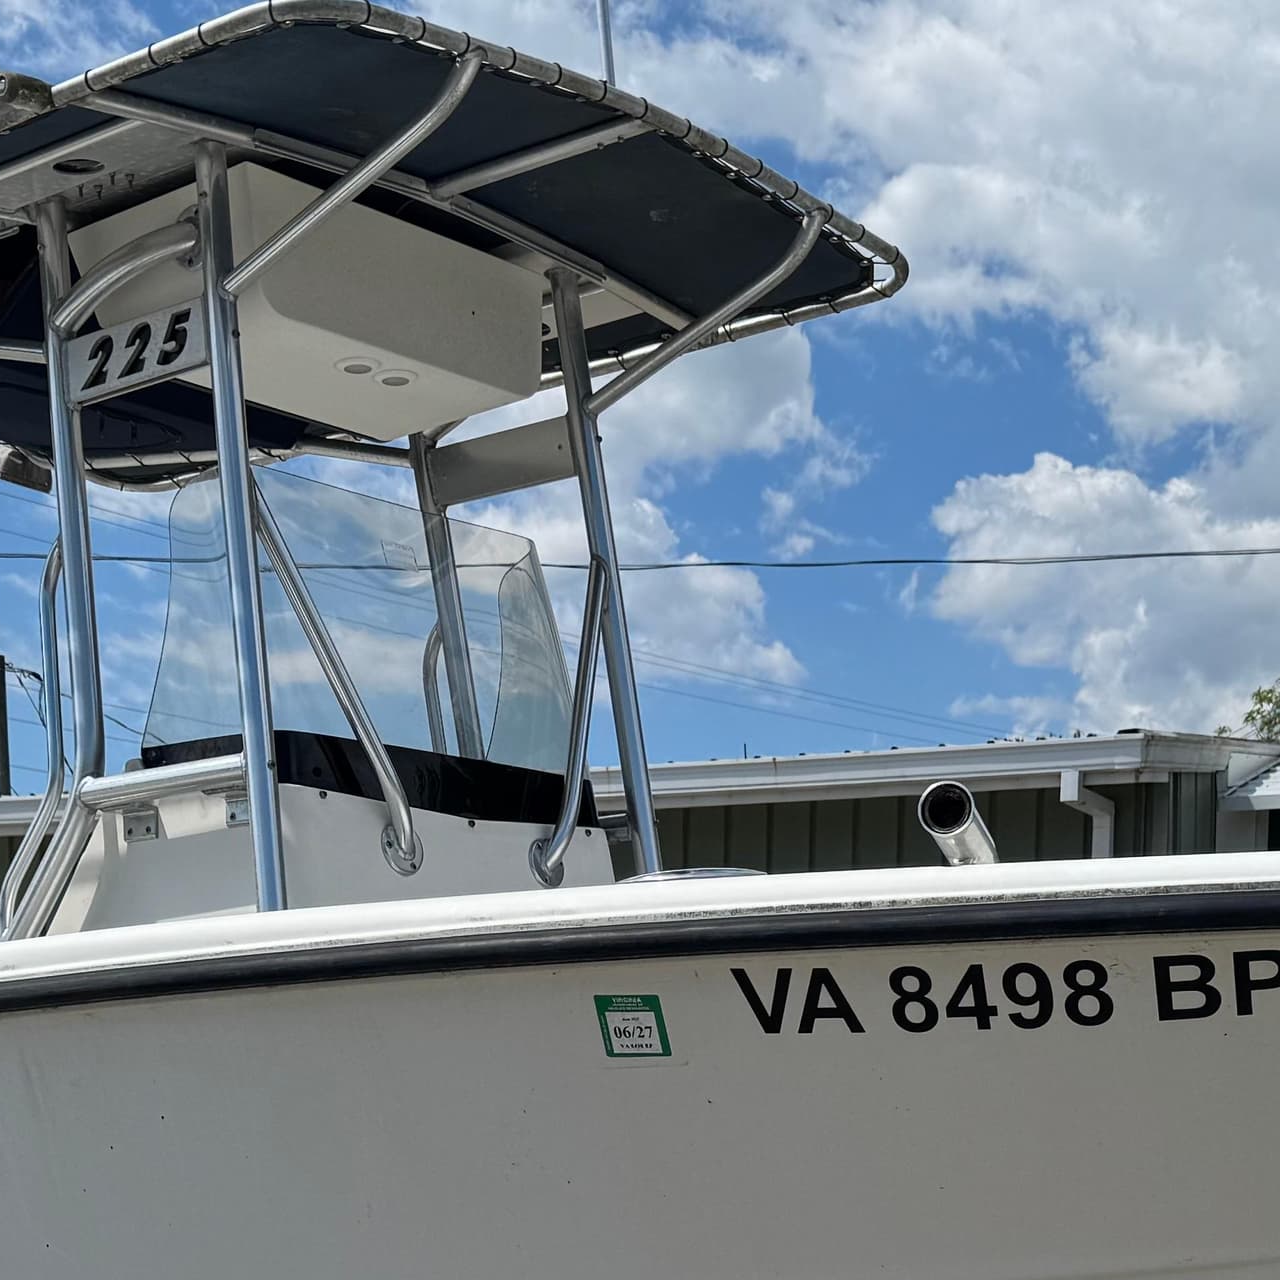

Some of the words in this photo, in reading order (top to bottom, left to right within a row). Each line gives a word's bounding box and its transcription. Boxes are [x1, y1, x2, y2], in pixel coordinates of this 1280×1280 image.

[80, 308, 192, 391] 225
[613, 1025, 653, 1039] 06/27
[729, 967, 866, 1034] VA
[888, 960, 1114, 1033] 8498
